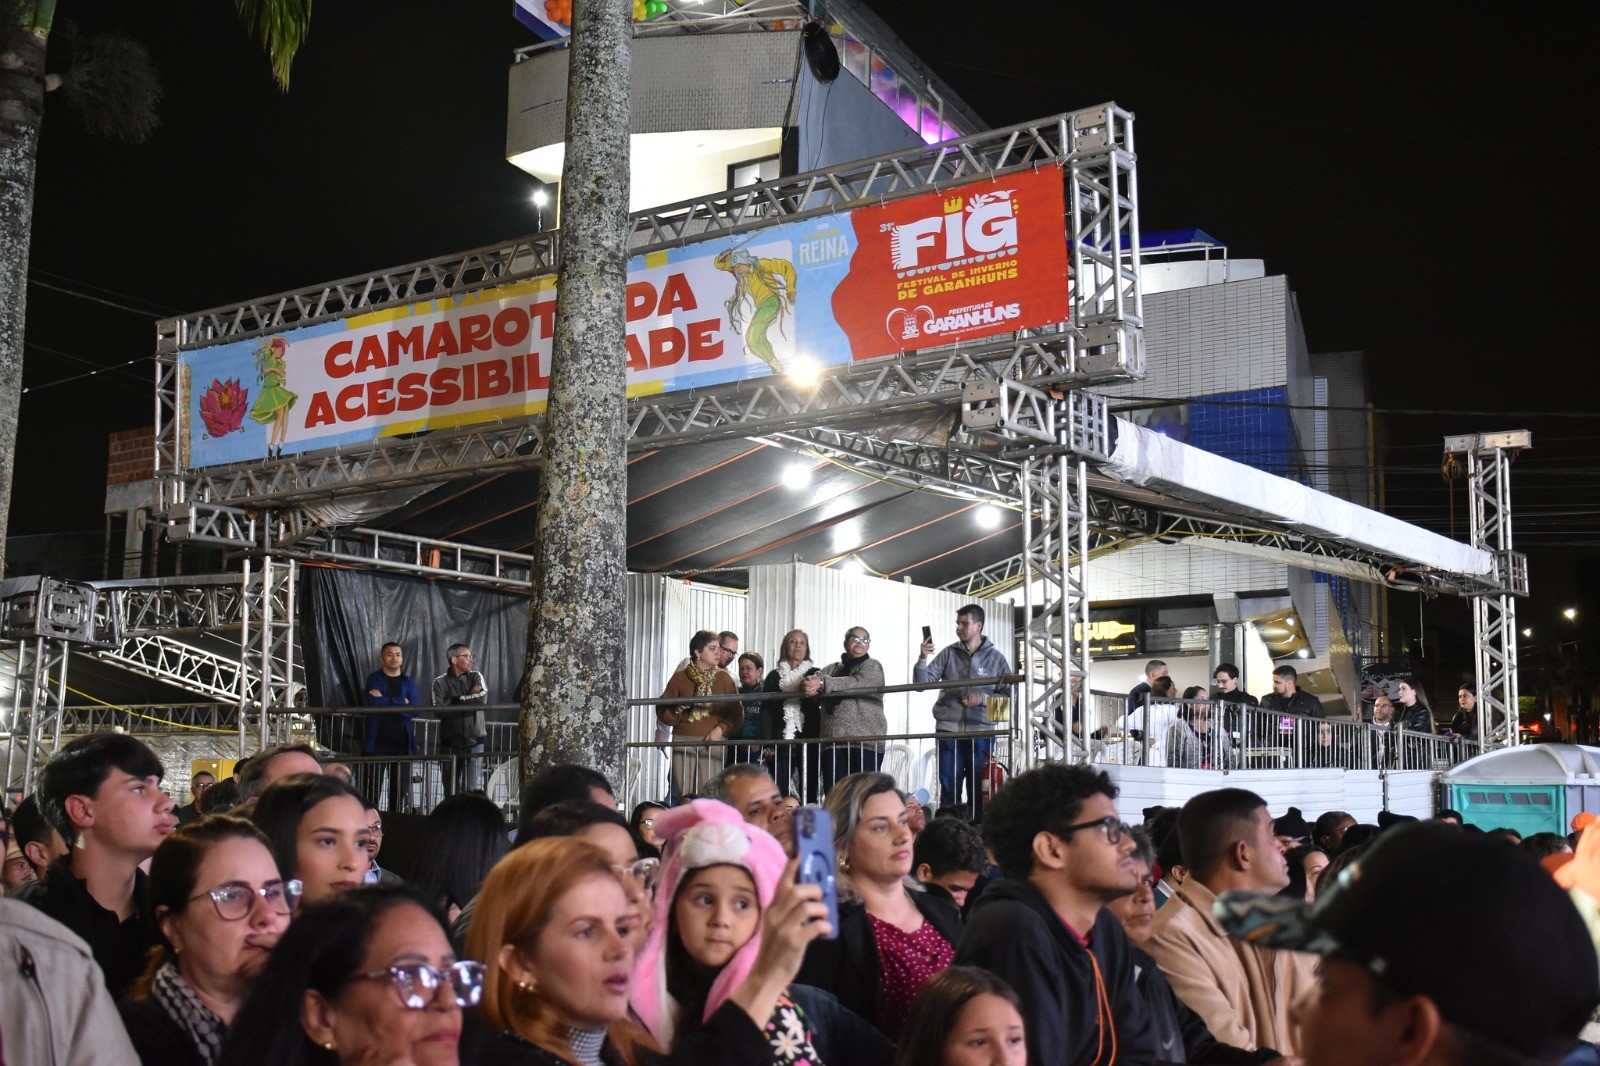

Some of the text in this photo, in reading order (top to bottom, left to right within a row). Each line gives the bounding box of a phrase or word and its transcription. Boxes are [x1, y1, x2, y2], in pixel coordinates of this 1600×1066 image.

[800, 234, 849, 265] REINA
[892, 198, 1018, 270] FIG
[897, 259, 1018, 289] FESTIVAL DE INVERNO
[898, 268, 1018, 300] DE GARANHUNS
[923, 303, 1021, 334] GARANHUNS
[948, 303, 985, 315] PREFEITURA
[324, 273, 697, 378] CAMAROT DA
